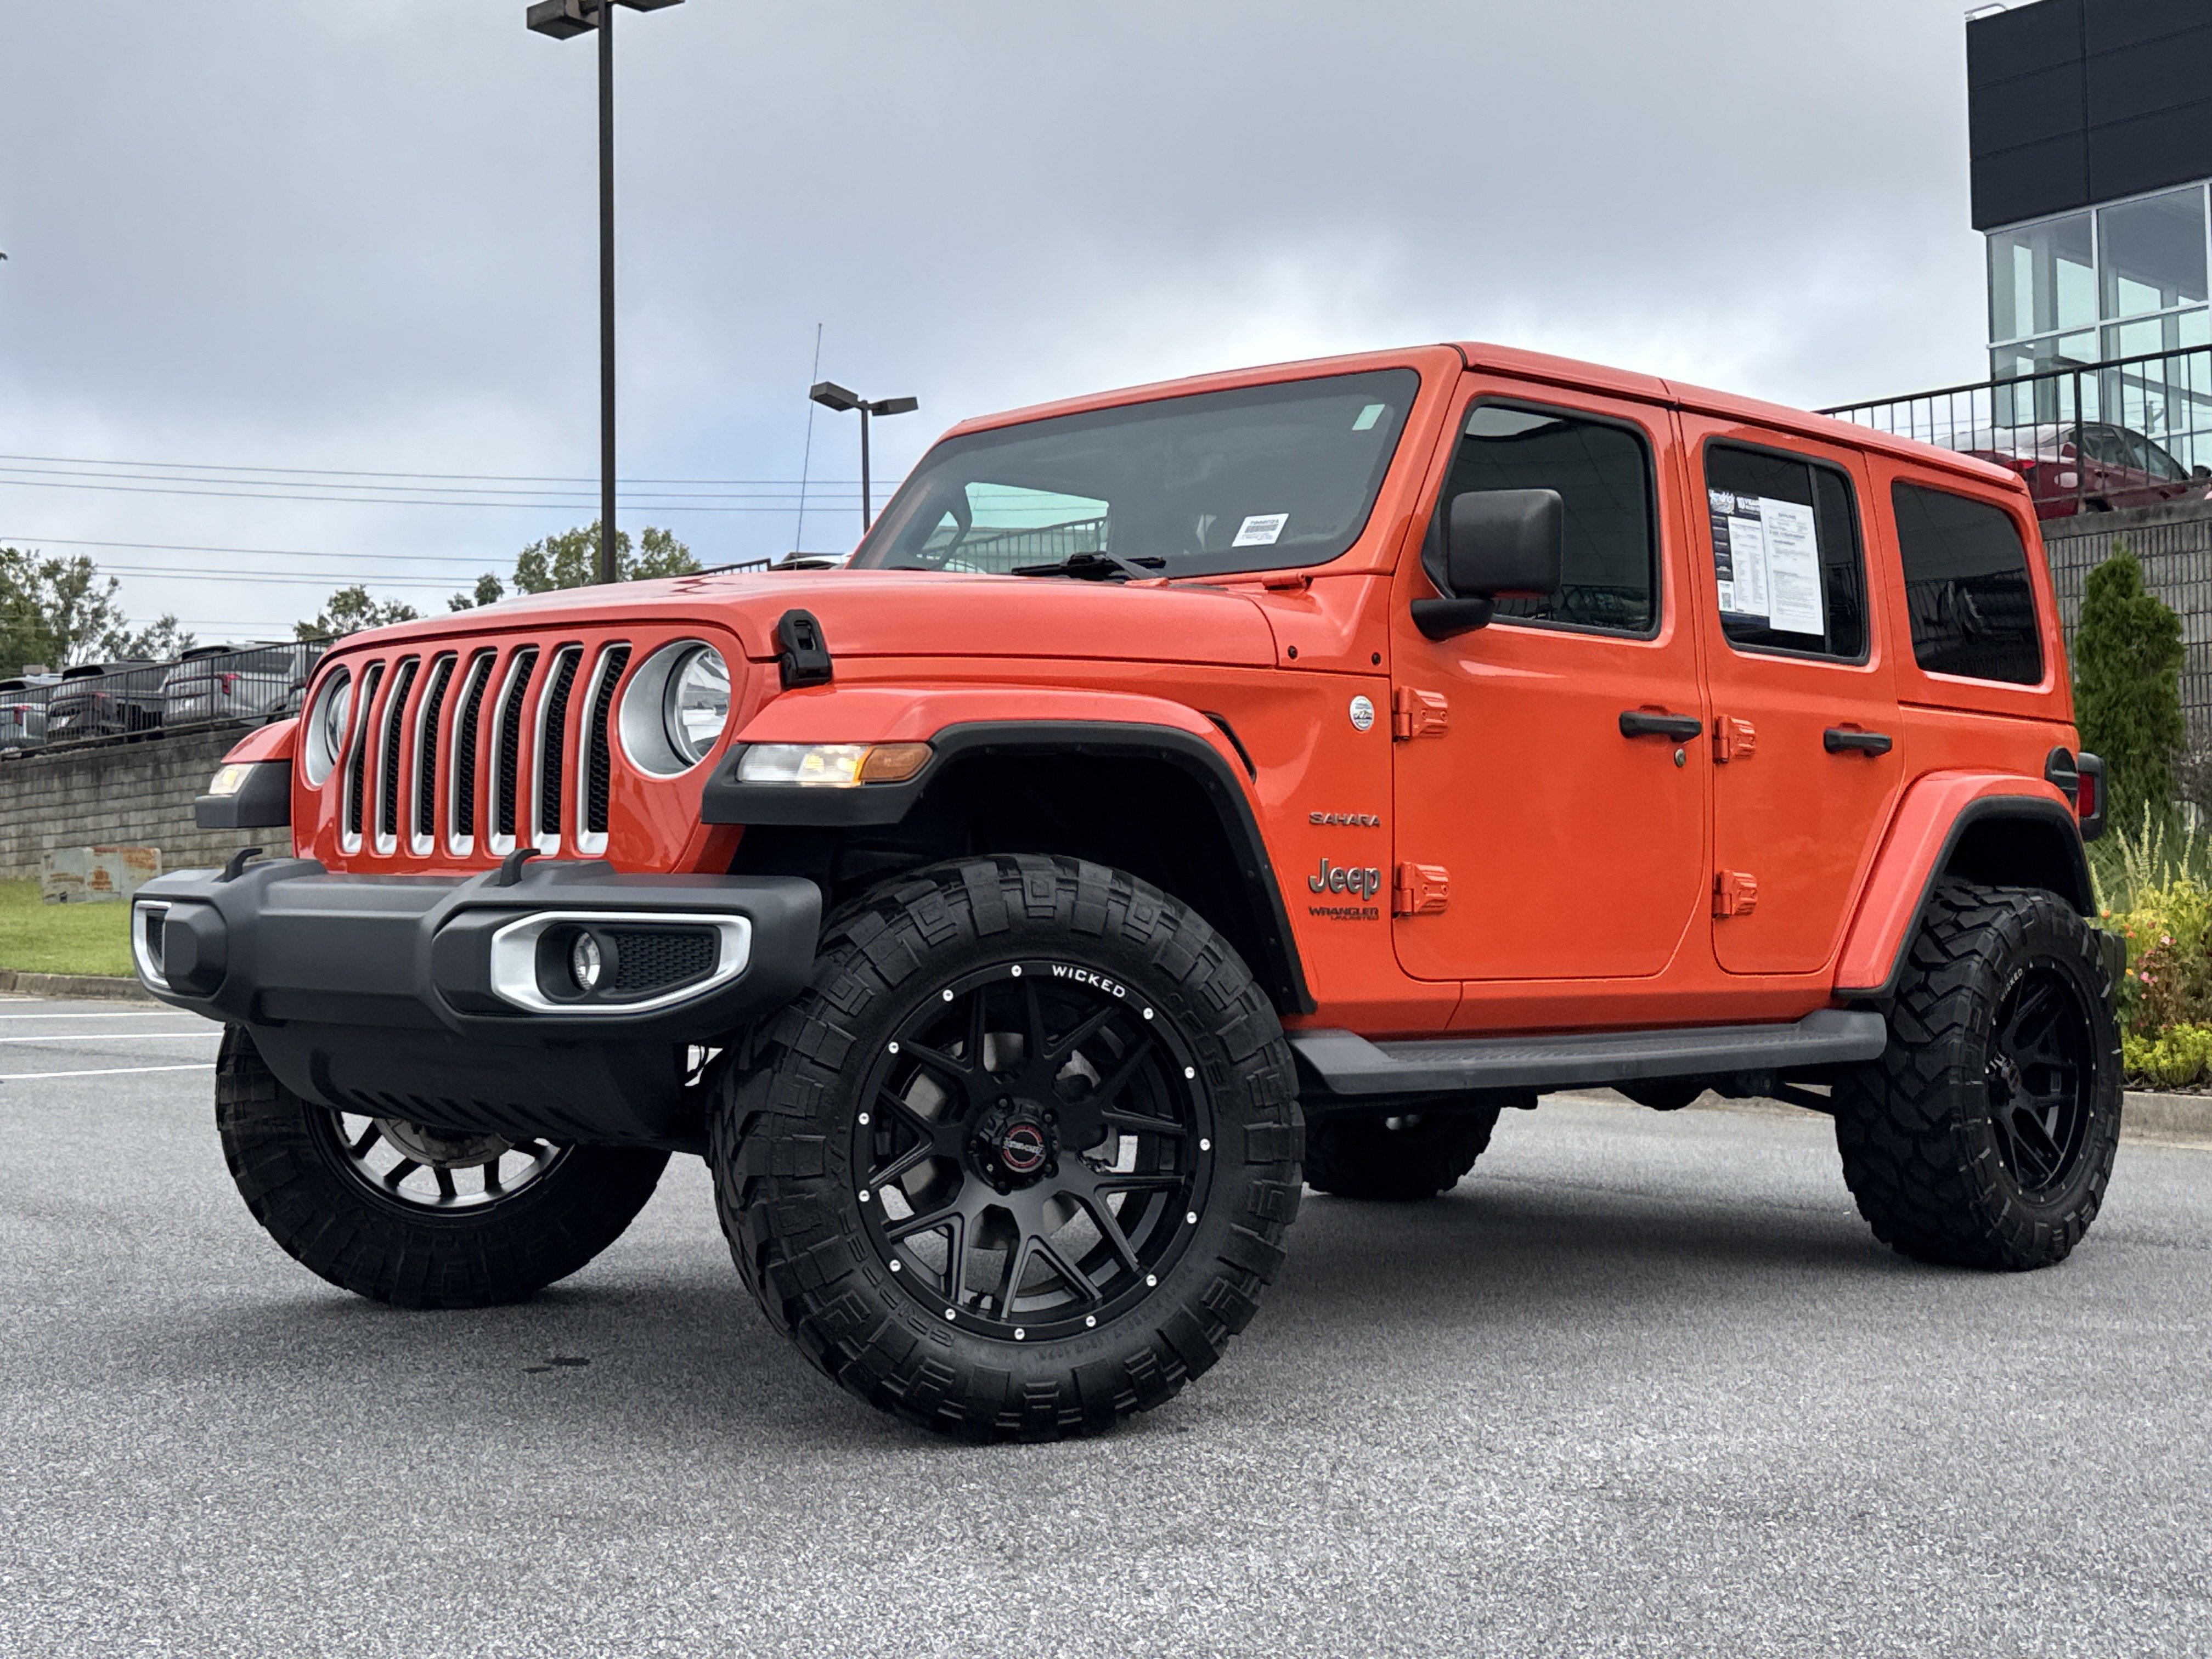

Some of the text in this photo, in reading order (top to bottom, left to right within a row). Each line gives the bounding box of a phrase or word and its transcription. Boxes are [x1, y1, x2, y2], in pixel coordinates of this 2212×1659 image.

[1309, 811, 1380, 827] SAHARA
[1308, 857, 1380, 900] Jeep
[1308, 906, 1379, 916] WRANGLER
[1052, 964, 1126, 998] WICKED
